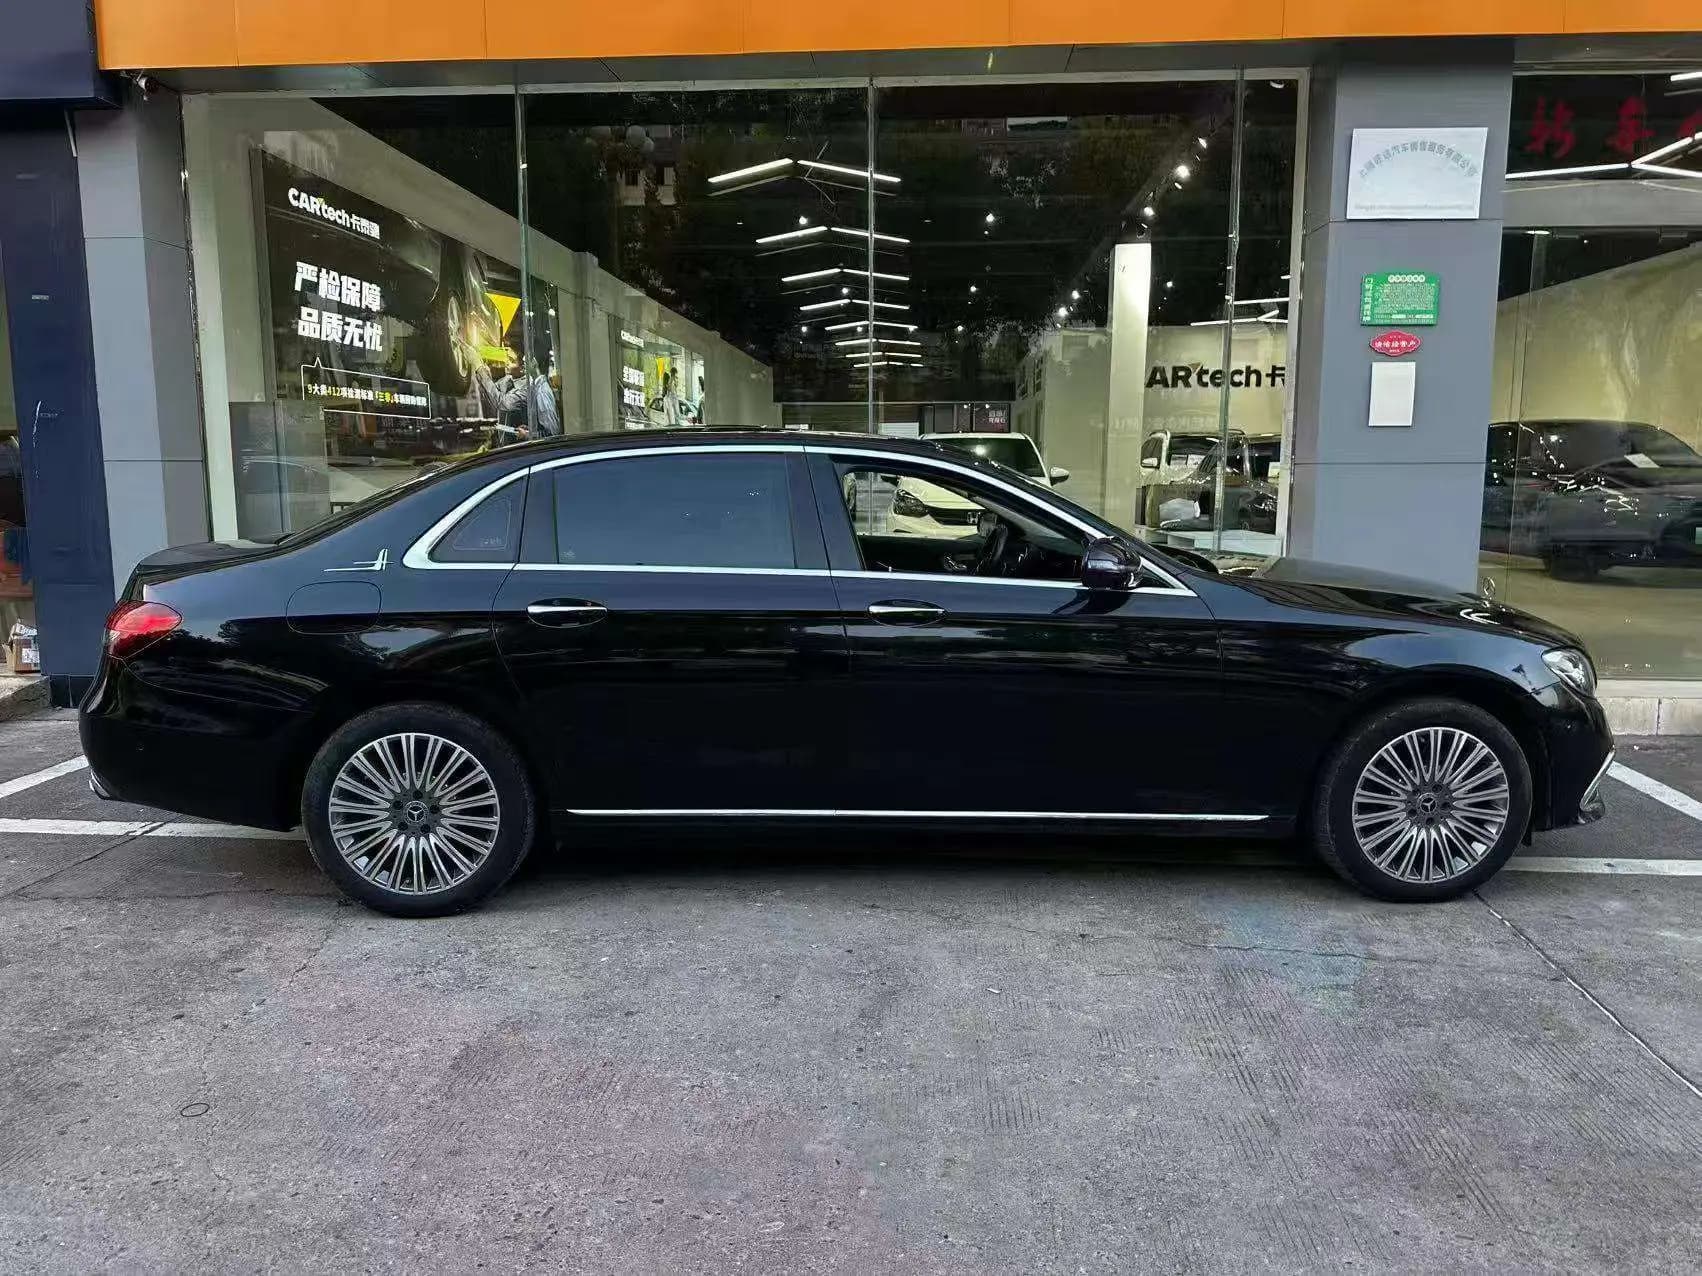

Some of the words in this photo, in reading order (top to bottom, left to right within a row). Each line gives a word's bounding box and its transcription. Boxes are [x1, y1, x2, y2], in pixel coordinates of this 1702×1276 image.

[294, 261, 382, 312] 严检保障
[297, 305, 383, 352] 品质无忧
